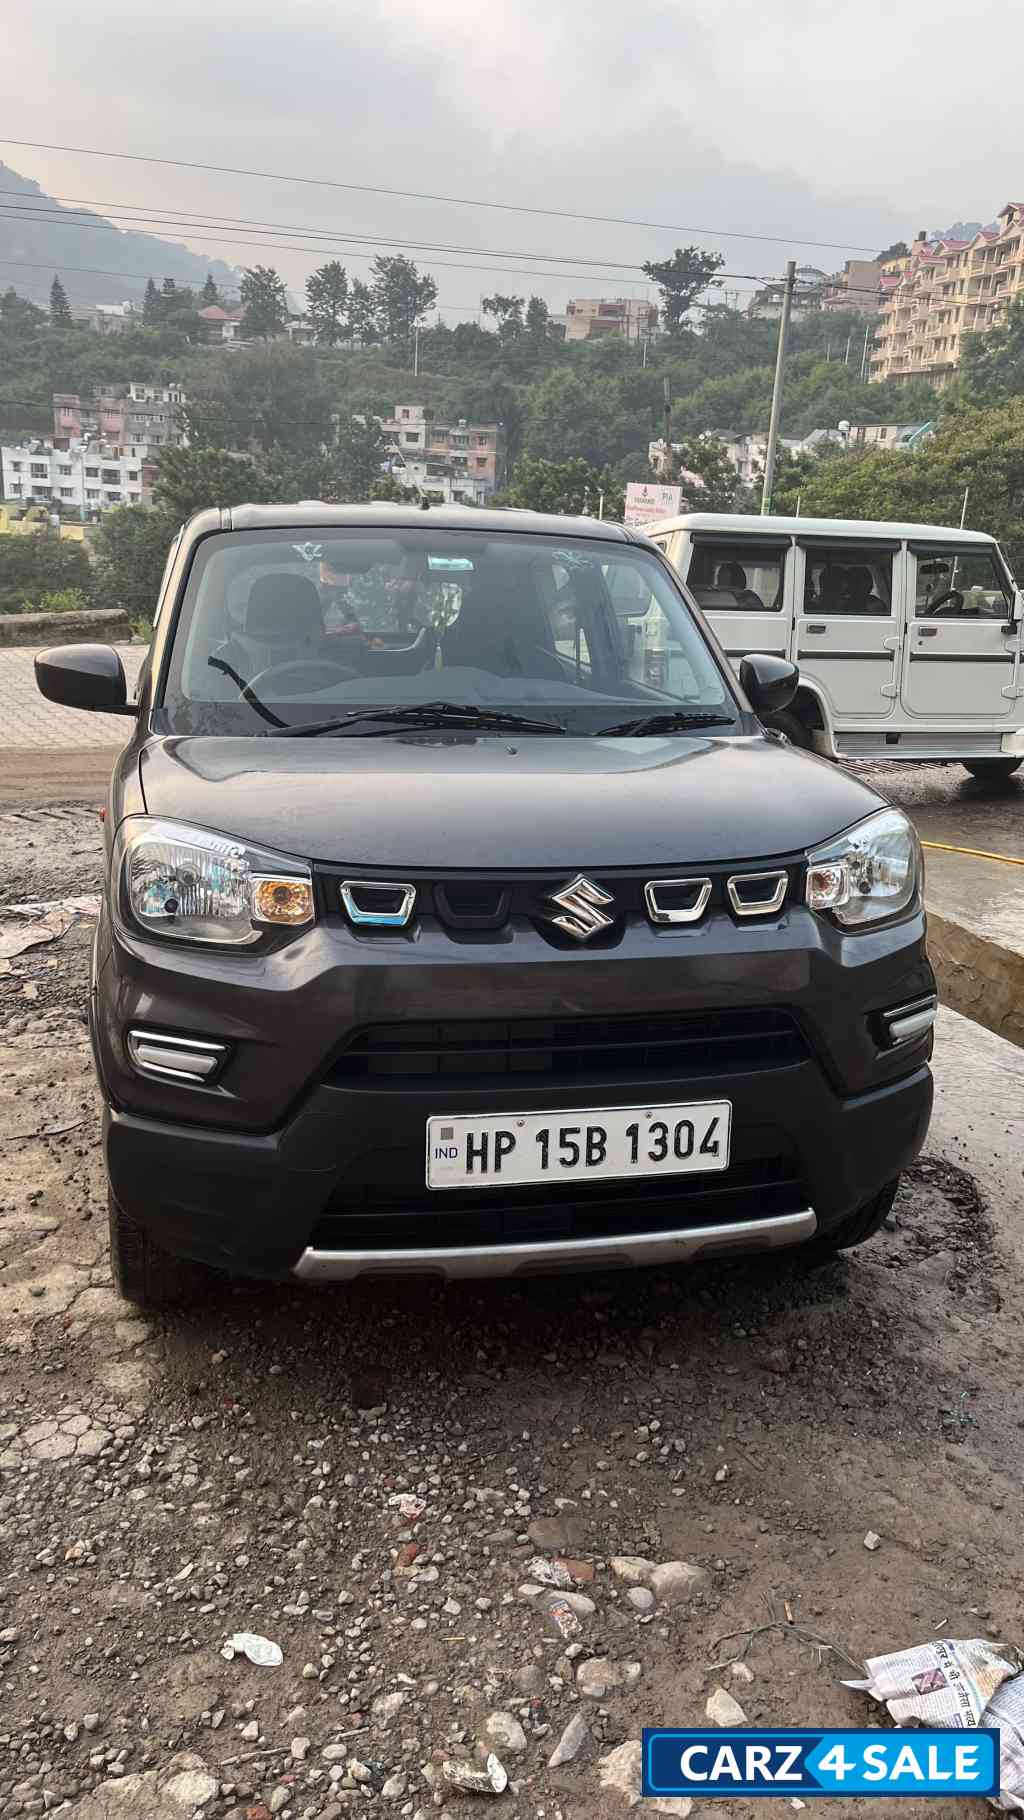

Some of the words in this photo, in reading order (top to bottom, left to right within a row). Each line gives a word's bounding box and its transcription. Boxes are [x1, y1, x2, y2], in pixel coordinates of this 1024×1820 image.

[434, 1147, 458, 1159] IND
[465, 1130, 516, 1175] HP
[535, 1126, 608, 1169] 15B
[625, 1117, 720, 1164] 1304
